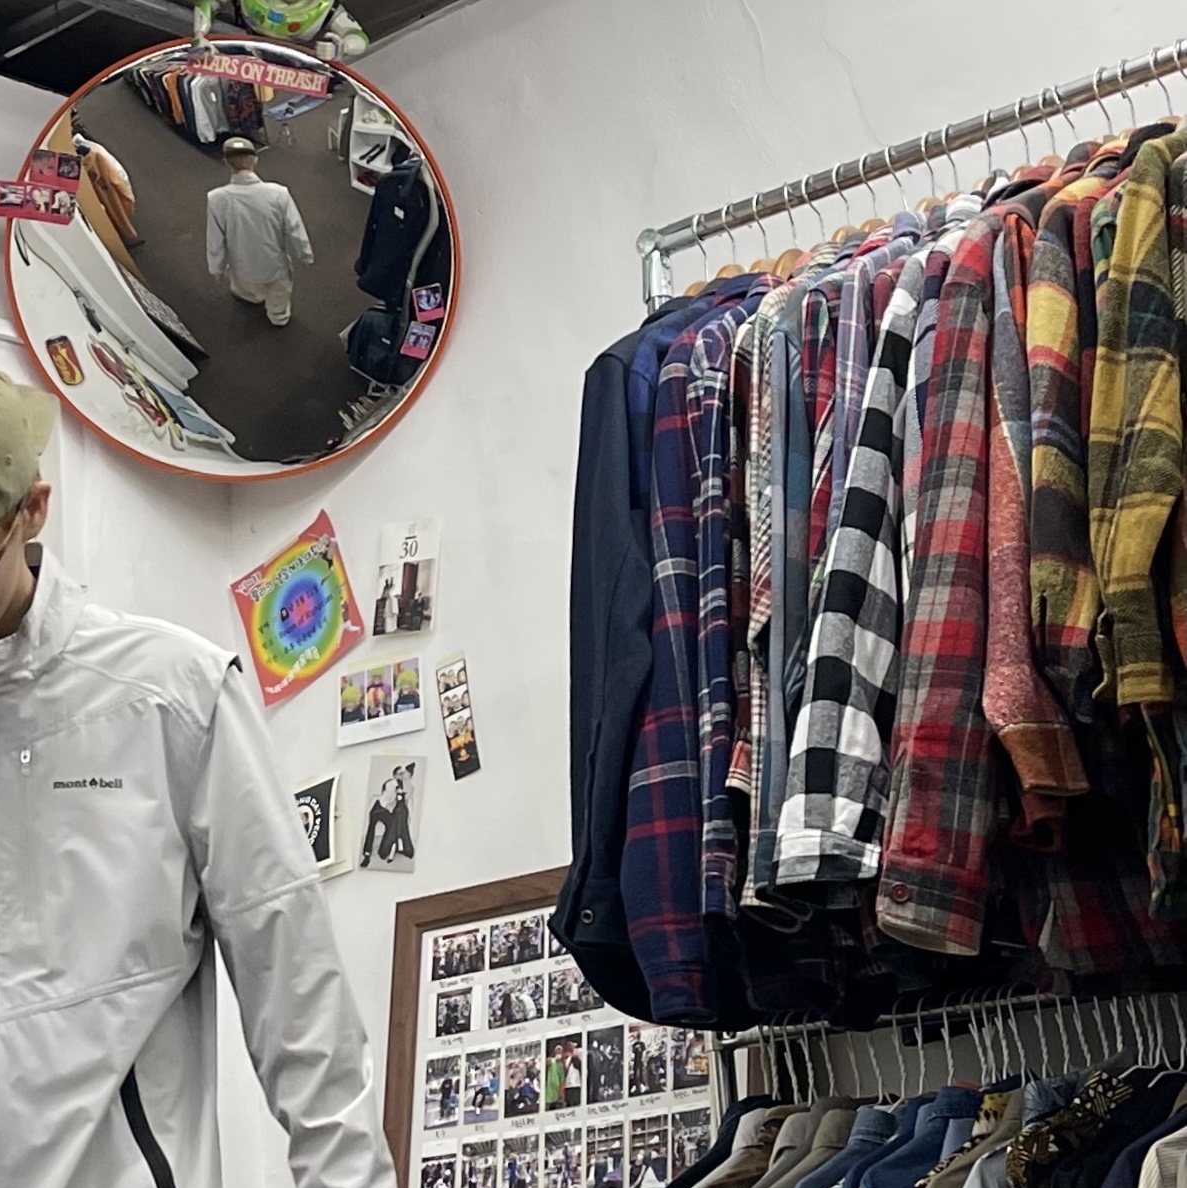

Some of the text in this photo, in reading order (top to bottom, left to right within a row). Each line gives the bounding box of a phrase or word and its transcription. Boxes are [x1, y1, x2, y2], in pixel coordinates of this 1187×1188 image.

[241, 62, 264, 82] ON
[265, 65, 326, 92] THRASH
[399, 540, 419, 559] 30
